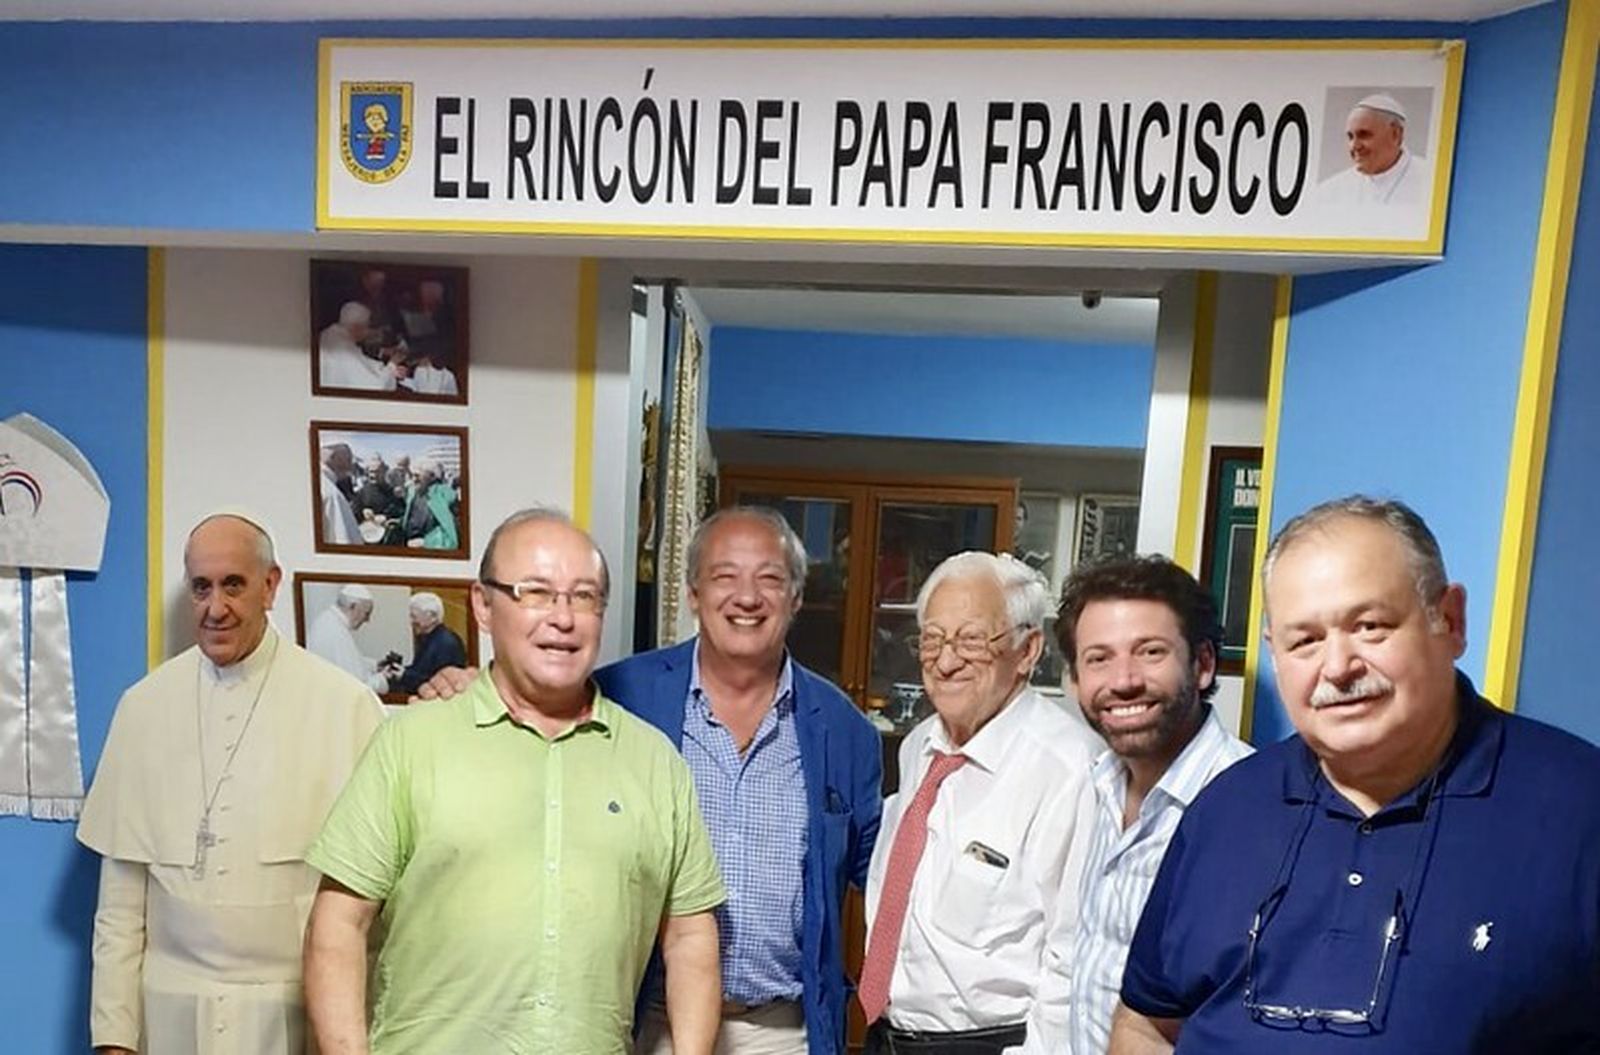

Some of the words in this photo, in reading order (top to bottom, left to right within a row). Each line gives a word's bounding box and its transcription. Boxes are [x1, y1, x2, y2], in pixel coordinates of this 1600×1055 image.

[433, 96, 490, 199] EL
[507, 68, 698, 204] RINCÓN
[715, 99, 812, 206] DEL
[831, 100, 963, 208] PAPA
[981, 101, 1309, 216] FRANCISCO
